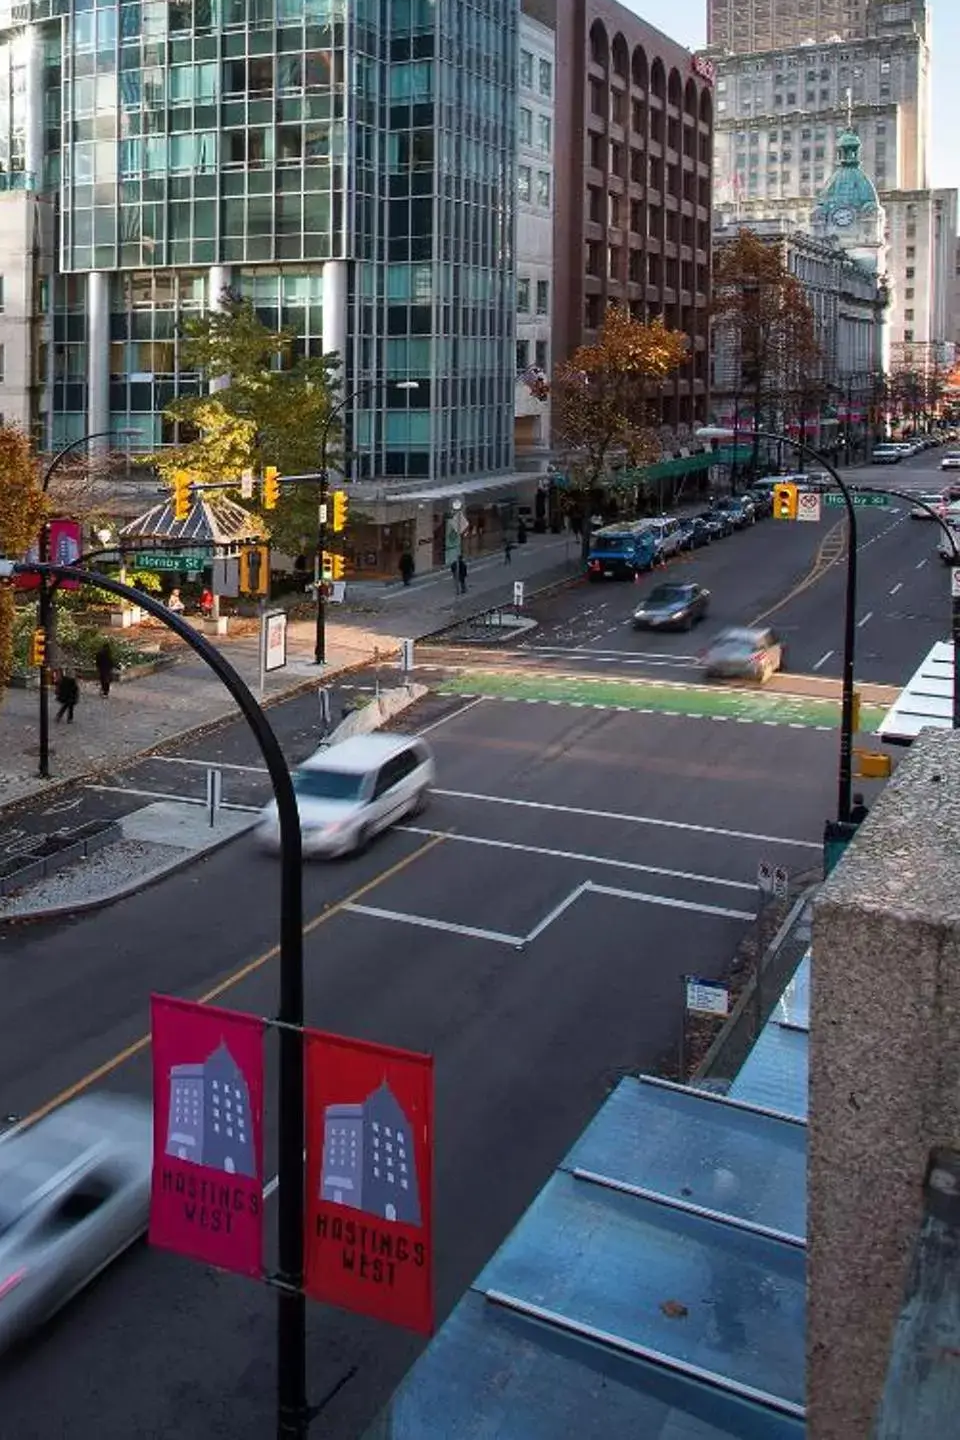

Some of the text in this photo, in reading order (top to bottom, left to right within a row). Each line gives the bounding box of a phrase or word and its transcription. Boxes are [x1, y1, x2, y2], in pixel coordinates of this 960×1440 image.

[139, 556, 199, 569] Hornby St
[162, 1168, 259, 1215] HASTINGS
[184, 1202, 232, 1234] WEST
[316, 1213, 424, 1268] HASTINGS
[342, 1247, 396, 1288] WEST
